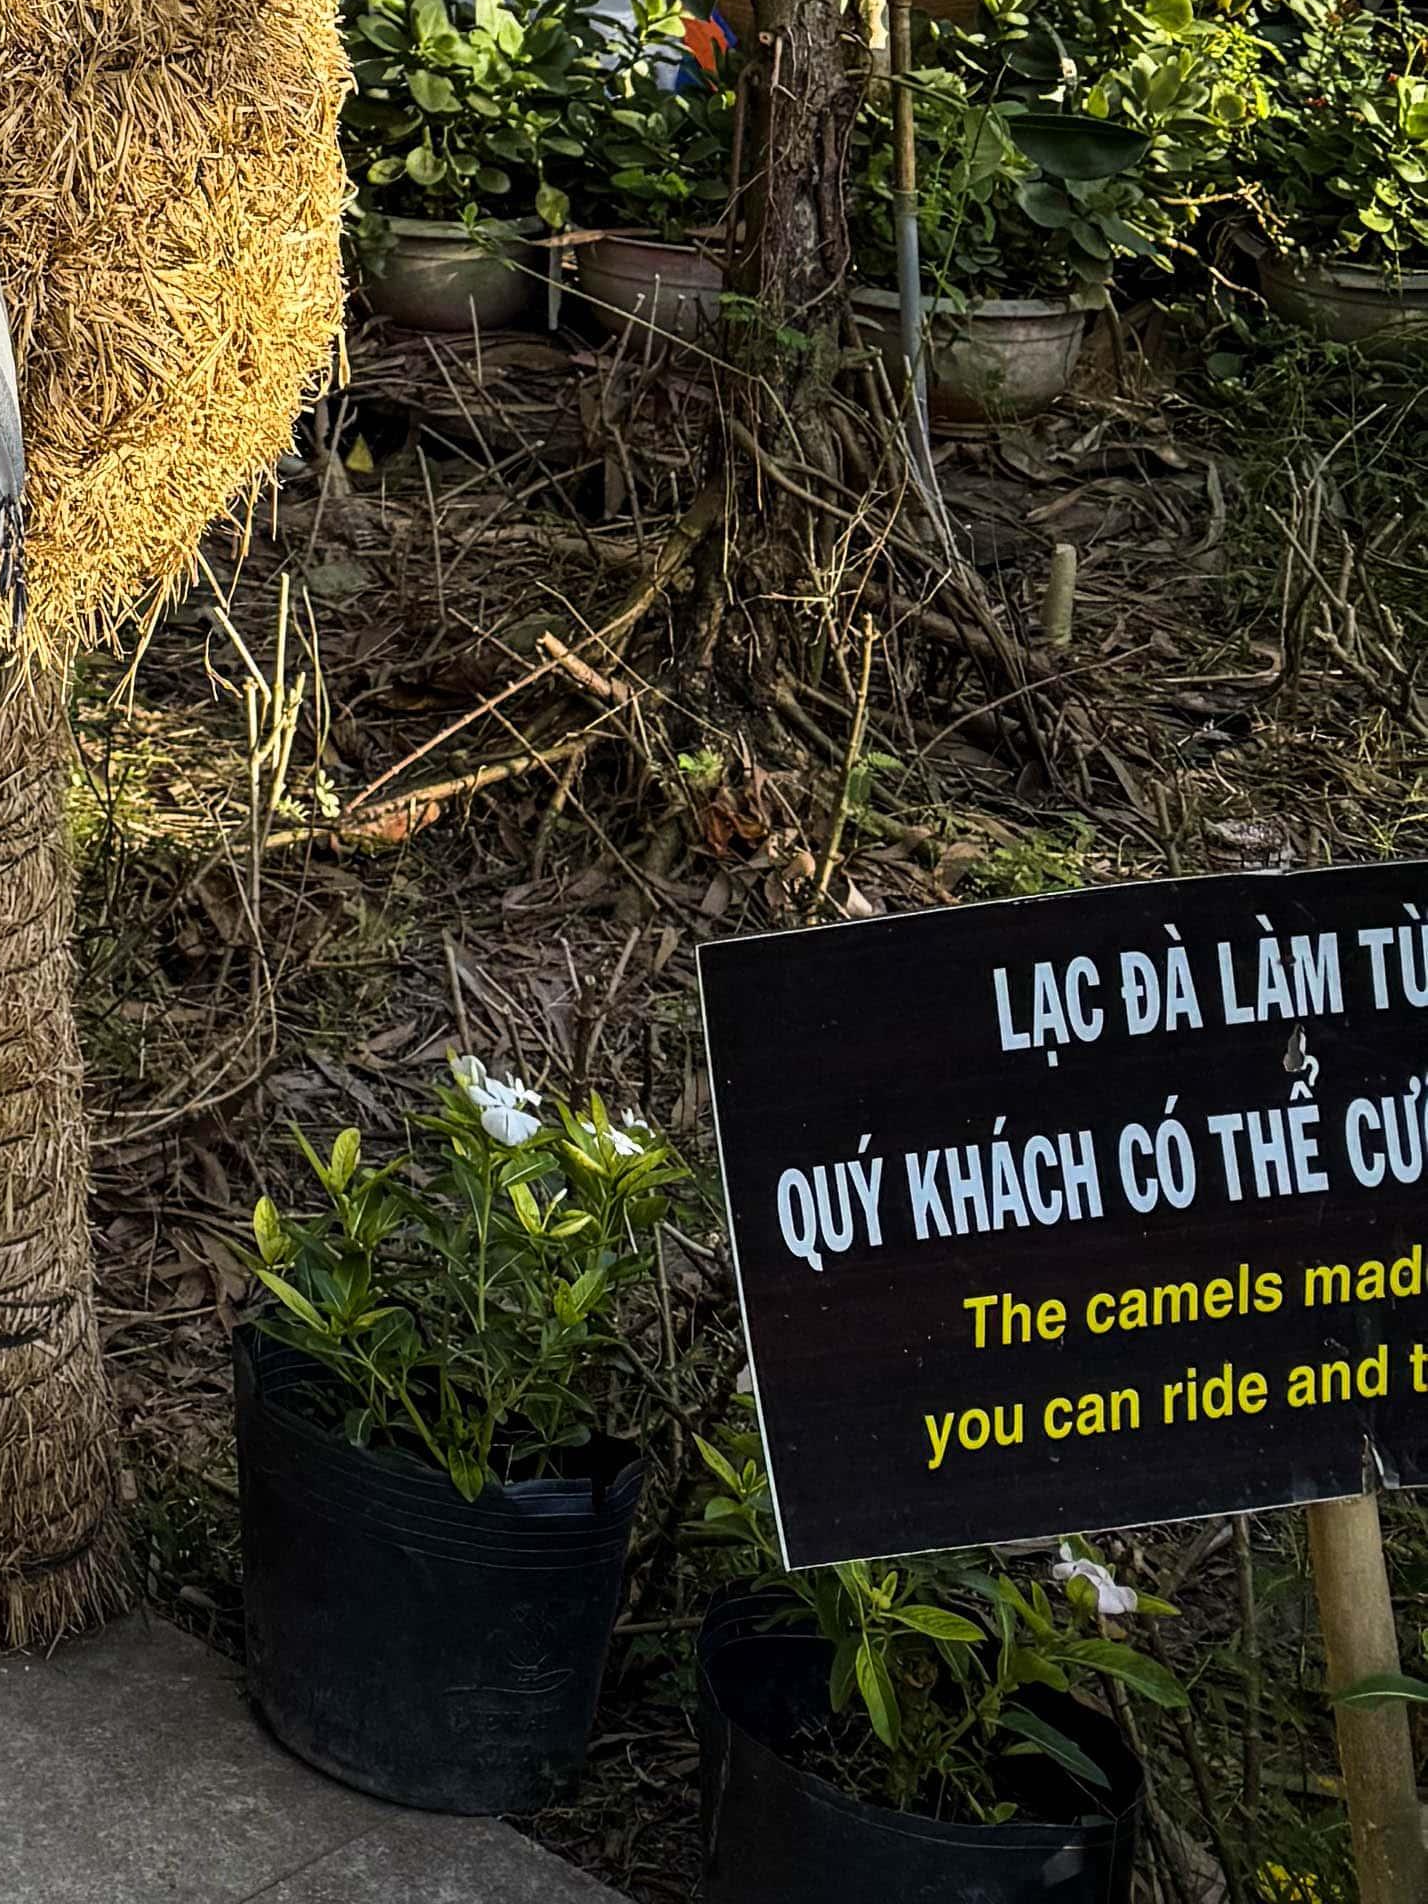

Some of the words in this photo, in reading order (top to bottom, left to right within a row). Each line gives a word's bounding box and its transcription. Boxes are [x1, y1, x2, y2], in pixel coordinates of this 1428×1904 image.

[993, 945, 1104, 1067] LẠC
[1121, 923, 1203, 1038] ĐÀ
[1218, 914, 1344, 1025] LÀM
[777, 1134, 885, 1272] QUÝ
[905, 1116, 1104, 1240] KHÁCH
[1119, 1096, 1197, 1215] CÓ
[1207, 1055, 1329, 1202] THỂ
[1346, 1076, 1428, 1188] CƯ
[964, 1293, 1067, 1348] The
[1085, 1264, 1284, 1330] camels
[1303, 1245, 1428, 1308] mad
[924, 1400, 1025, 1470] you
[1043, 1388, 1141, 1439] can
[1162, 1362, 1269, 1425] ride
[1286, 1345, 1388, 1407] and
